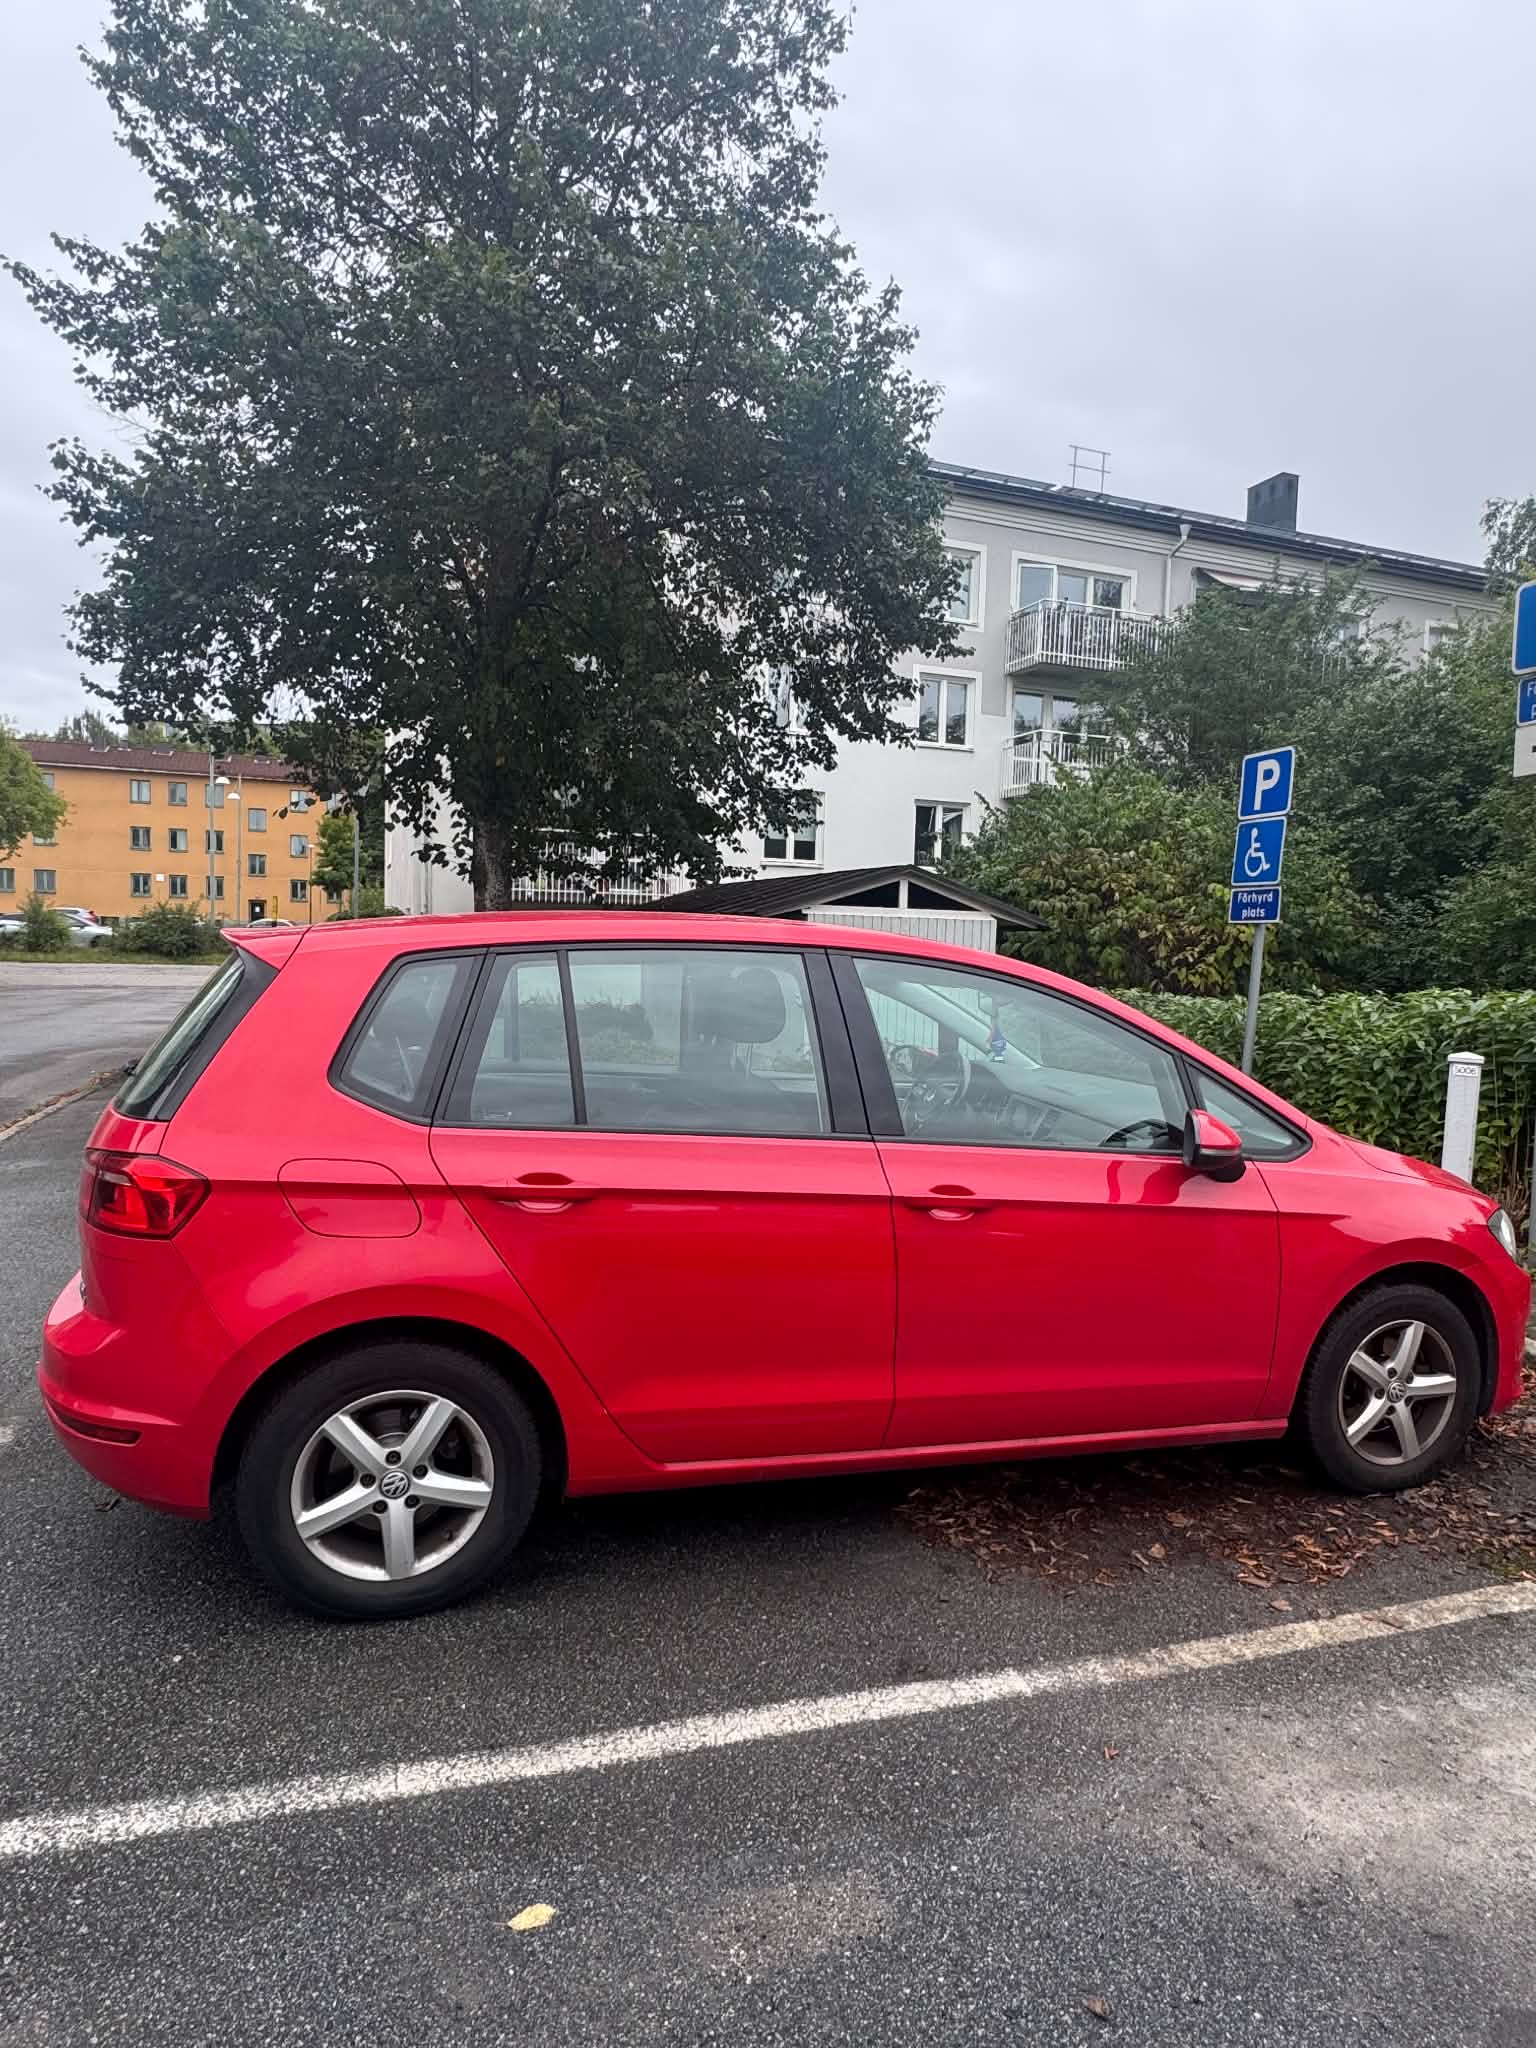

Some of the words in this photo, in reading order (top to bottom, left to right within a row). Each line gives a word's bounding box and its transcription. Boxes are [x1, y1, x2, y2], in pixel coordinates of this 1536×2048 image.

[1253, 759, 1281, 811] P
[1237, 891, 1273, 905] Förhyrd
[1241, 906, 1265, 920] plats
